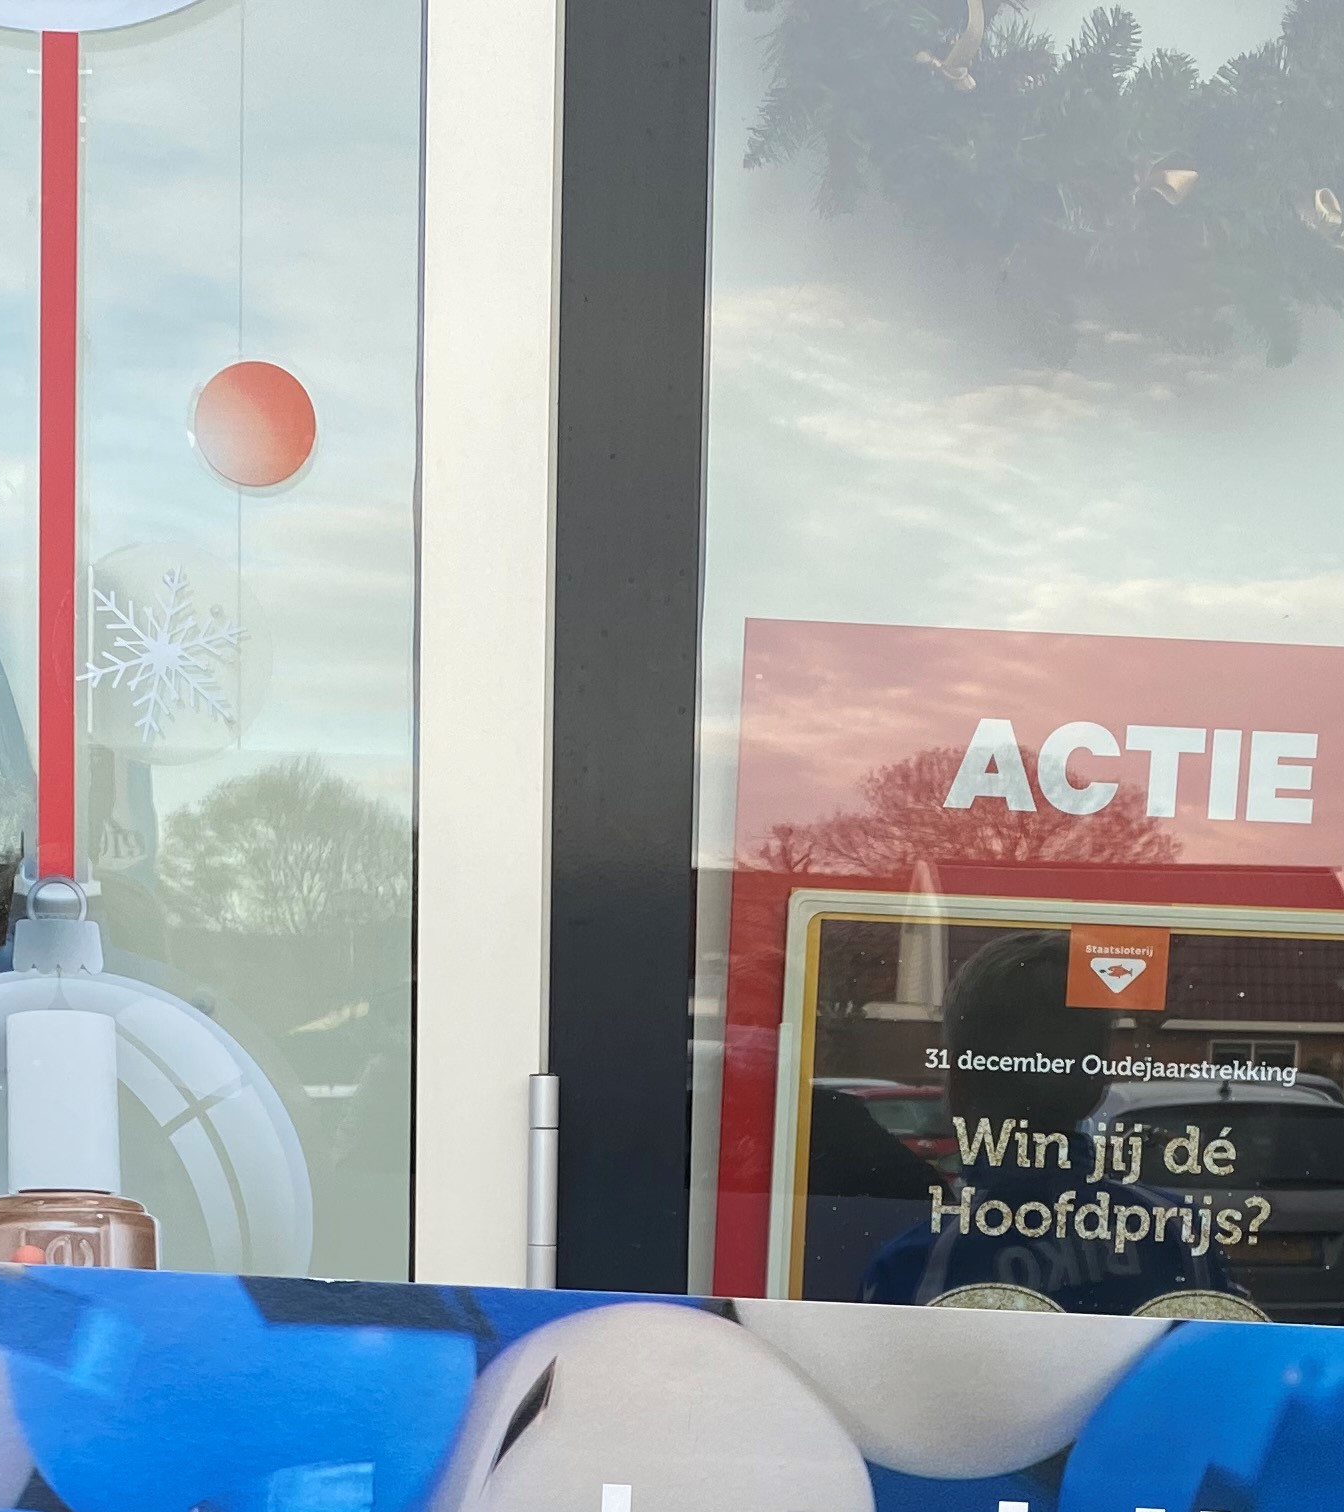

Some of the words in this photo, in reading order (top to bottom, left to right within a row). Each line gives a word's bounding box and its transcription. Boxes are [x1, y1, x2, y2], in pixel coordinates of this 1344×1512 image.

[943, 718, 1319, 824] ACTIE
[1086, 944, 1154, 958] Staatsloterij
[925, 1048, 951, 1069] 31
[957, 1050, 1075, 1075] december
[1081, 1054, 1299, 1086] Oudejaarstrekking
[953, 1116, 1072, 1169] Win
[1086, 1122, 1143, 1185] jij
[1163, 1125, 1237, 1176] dé
[928, 1185, 1272, 1257] Hoofdprijs?
